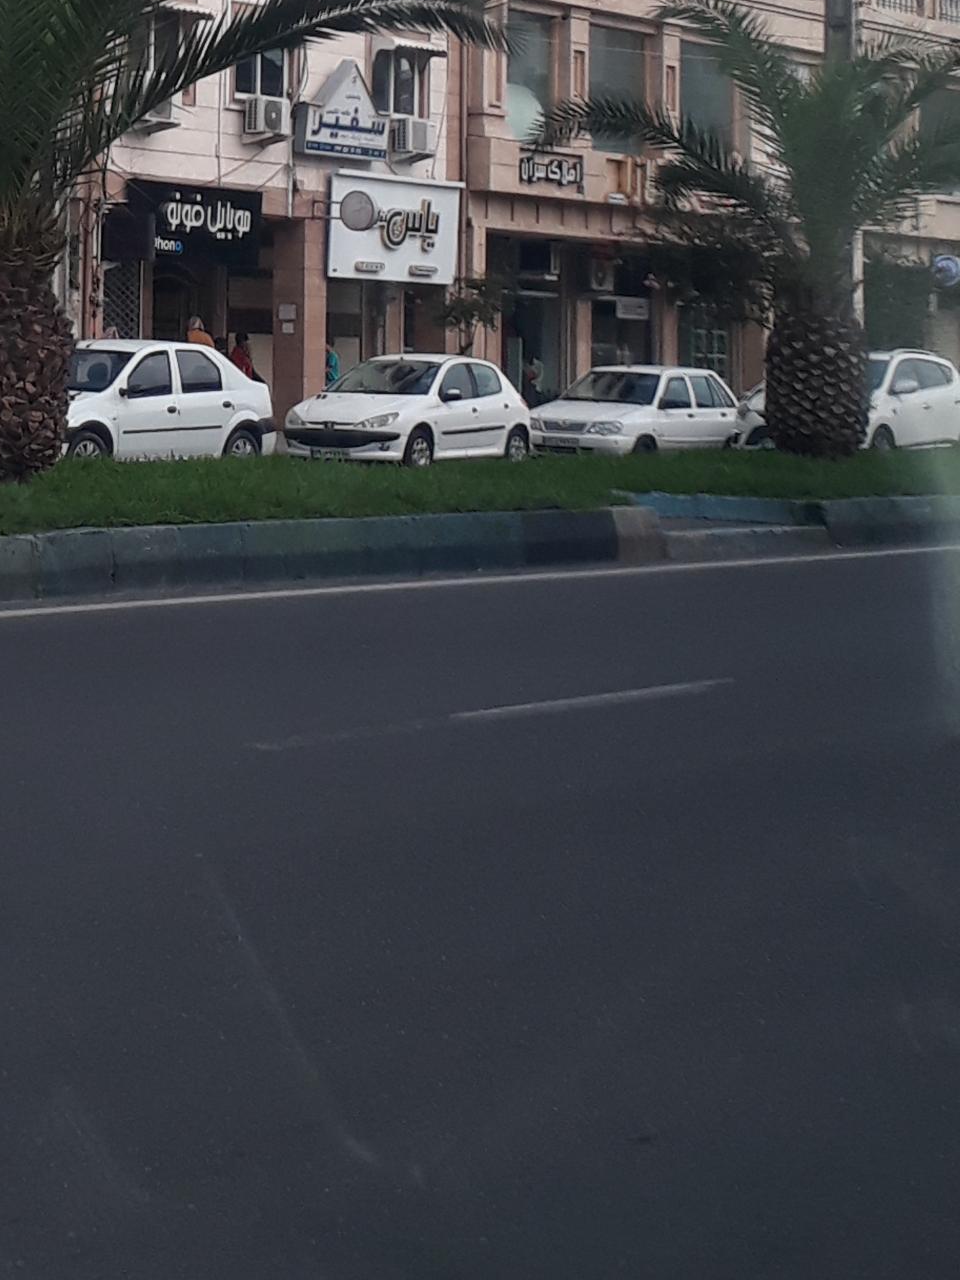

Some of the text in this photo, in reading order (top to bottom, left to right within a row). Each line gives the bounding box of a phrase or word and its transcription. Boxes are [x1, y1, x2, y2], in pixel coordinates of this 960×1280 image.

[311, 107, 385, 138] سفیر
[166, 192, 252, 240] موبایل فونو
